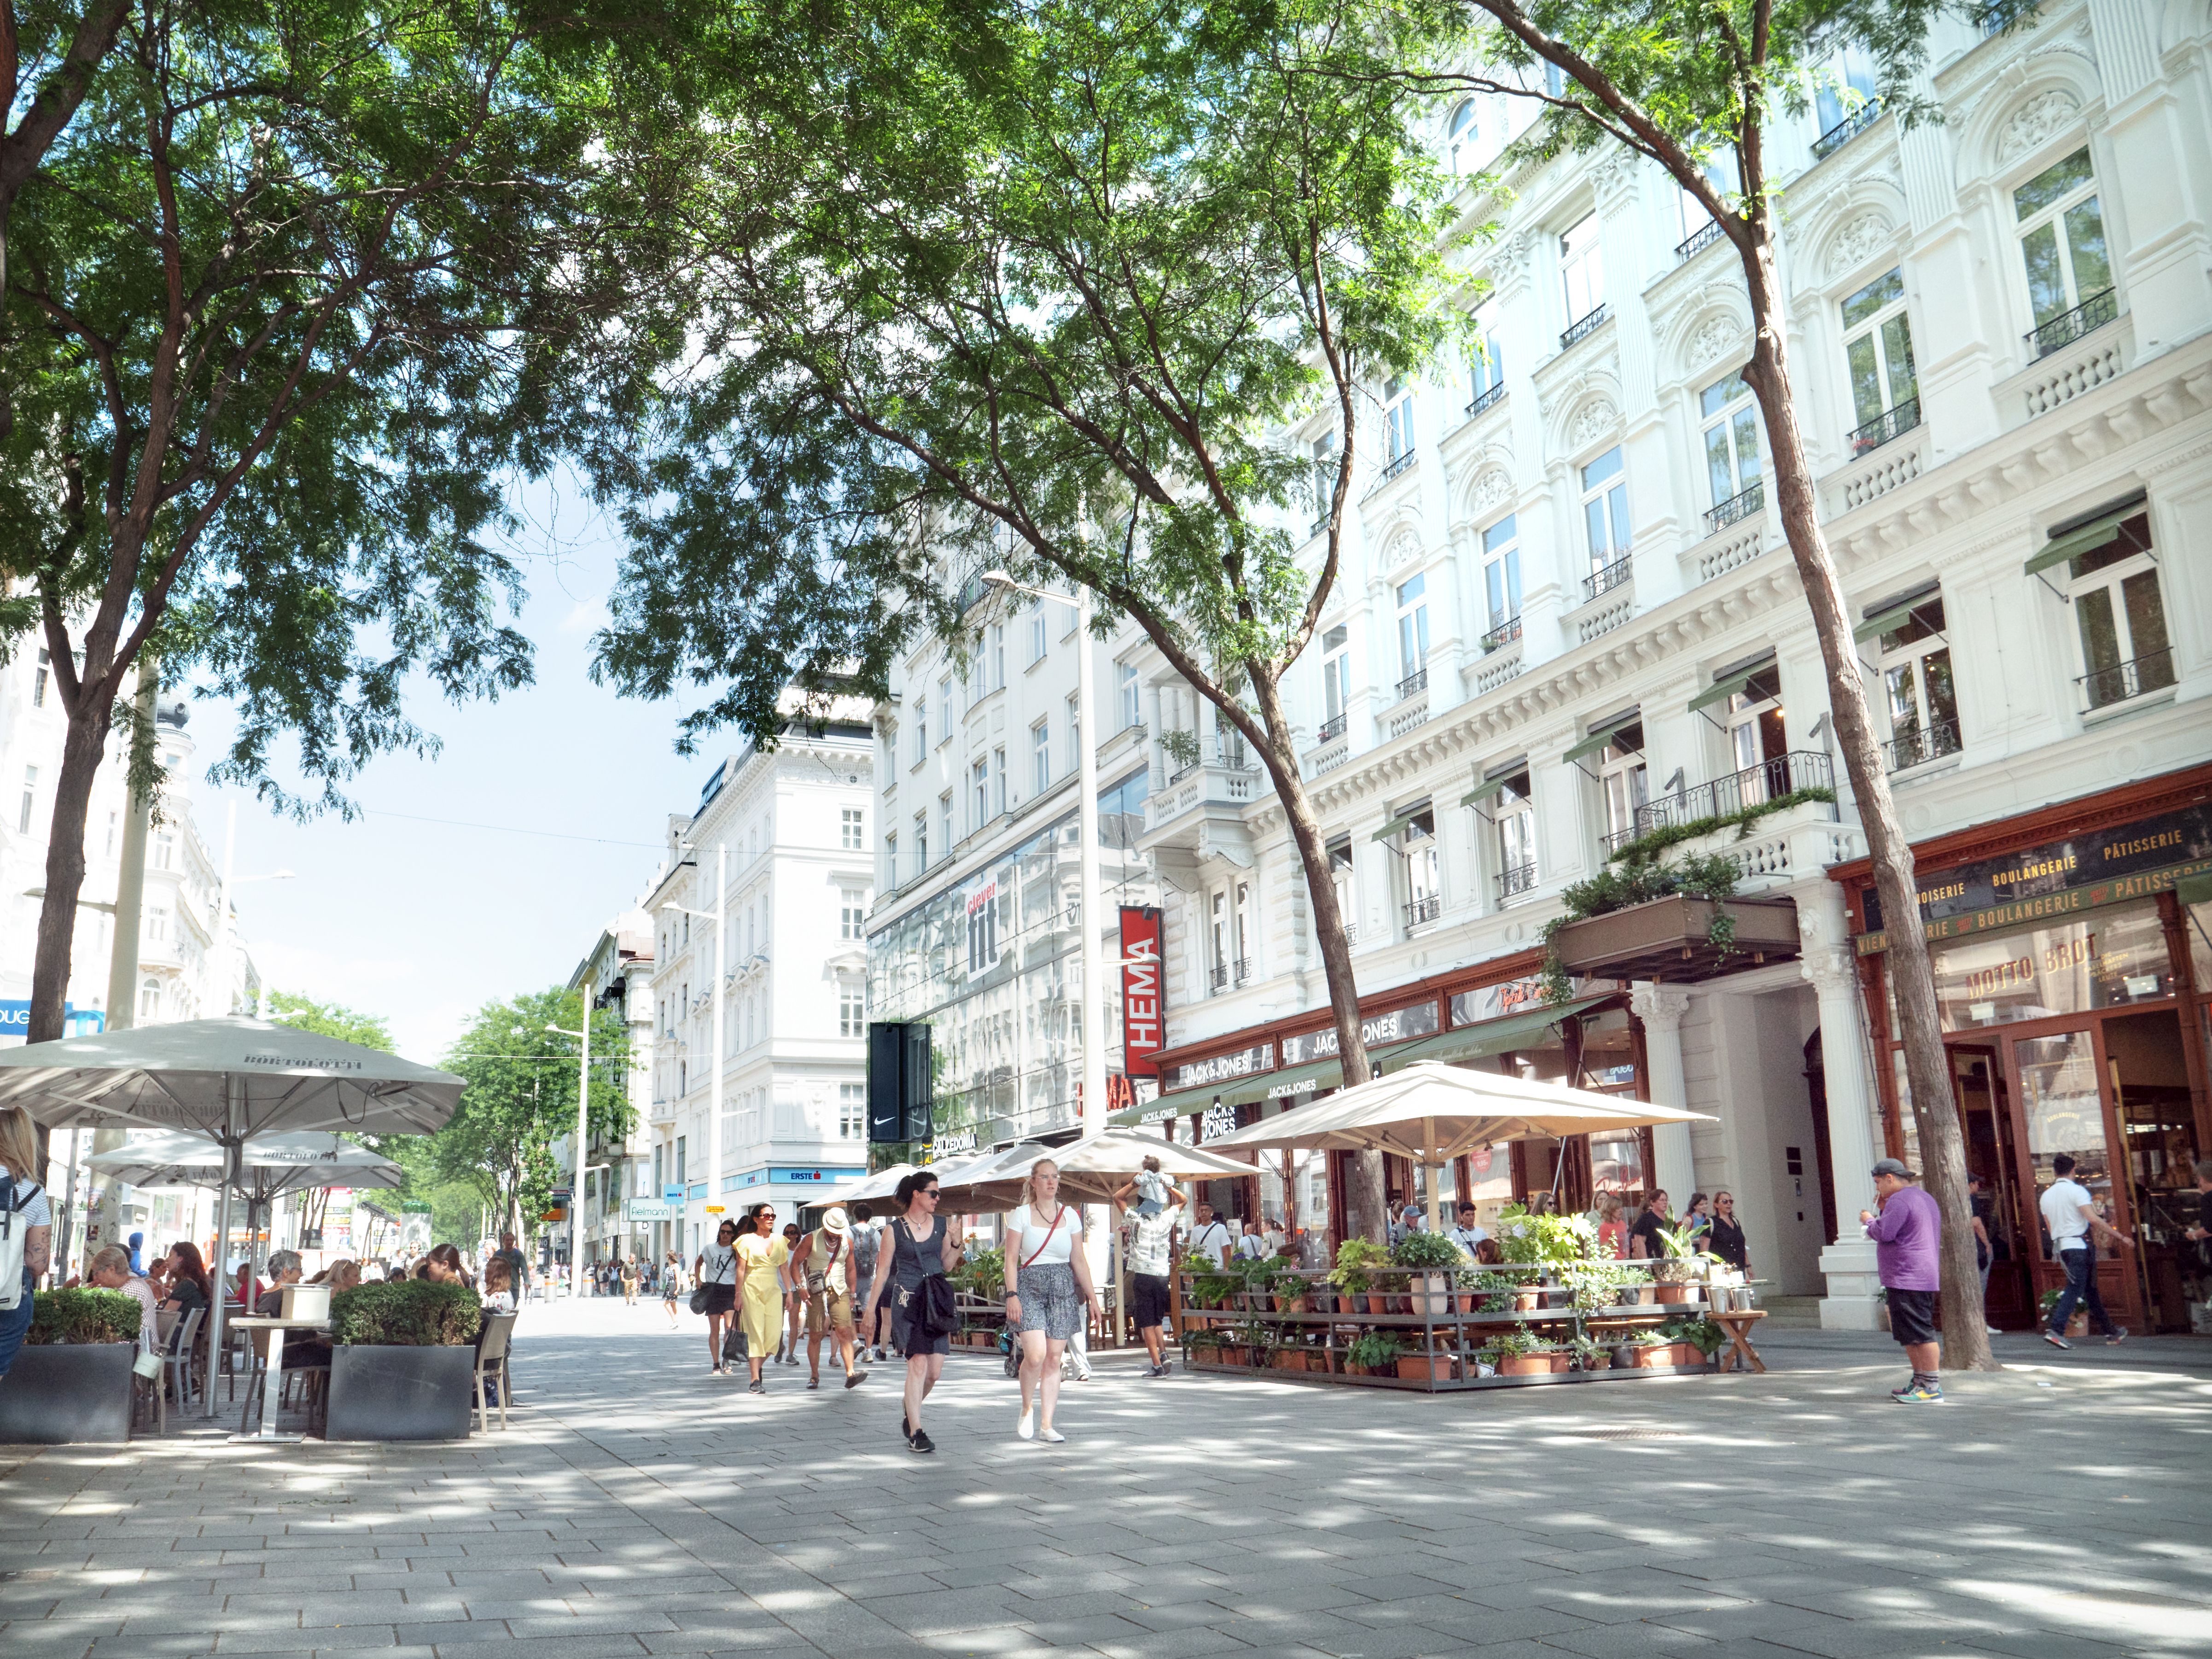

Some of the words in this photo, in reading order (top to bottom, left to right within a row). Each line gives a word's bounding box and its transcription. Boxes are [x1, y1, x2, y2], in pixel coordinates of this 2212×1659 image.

[2104, 830, 2183, 860] PÂTISSERIE
[1993, 856, 2076, 887] BOULANGERIE
[968, 881, 996, 914] clever
[1978, 892, 2079, 928] BOULANGERIE
[968, 897, 997, 974] fit
[1966, 956, 2034, 999] MOTTO
[2045, 933, 2096, 974] BROT
[1127, 937, 1158, 1048] HEMA
[244, 1054, 361, 1070] BORTOLOTTI
[1185, 1054, 1249, 1084] JACK&JONES
[1268, 1079, 1316, 1099] JACK&JONES
[1140, 1107, 1177, 1123] JACK&JONES
[1202, 1117, 1235, 1139] JONES
[932, 1133, 976, 1154] CALZEDONIA
